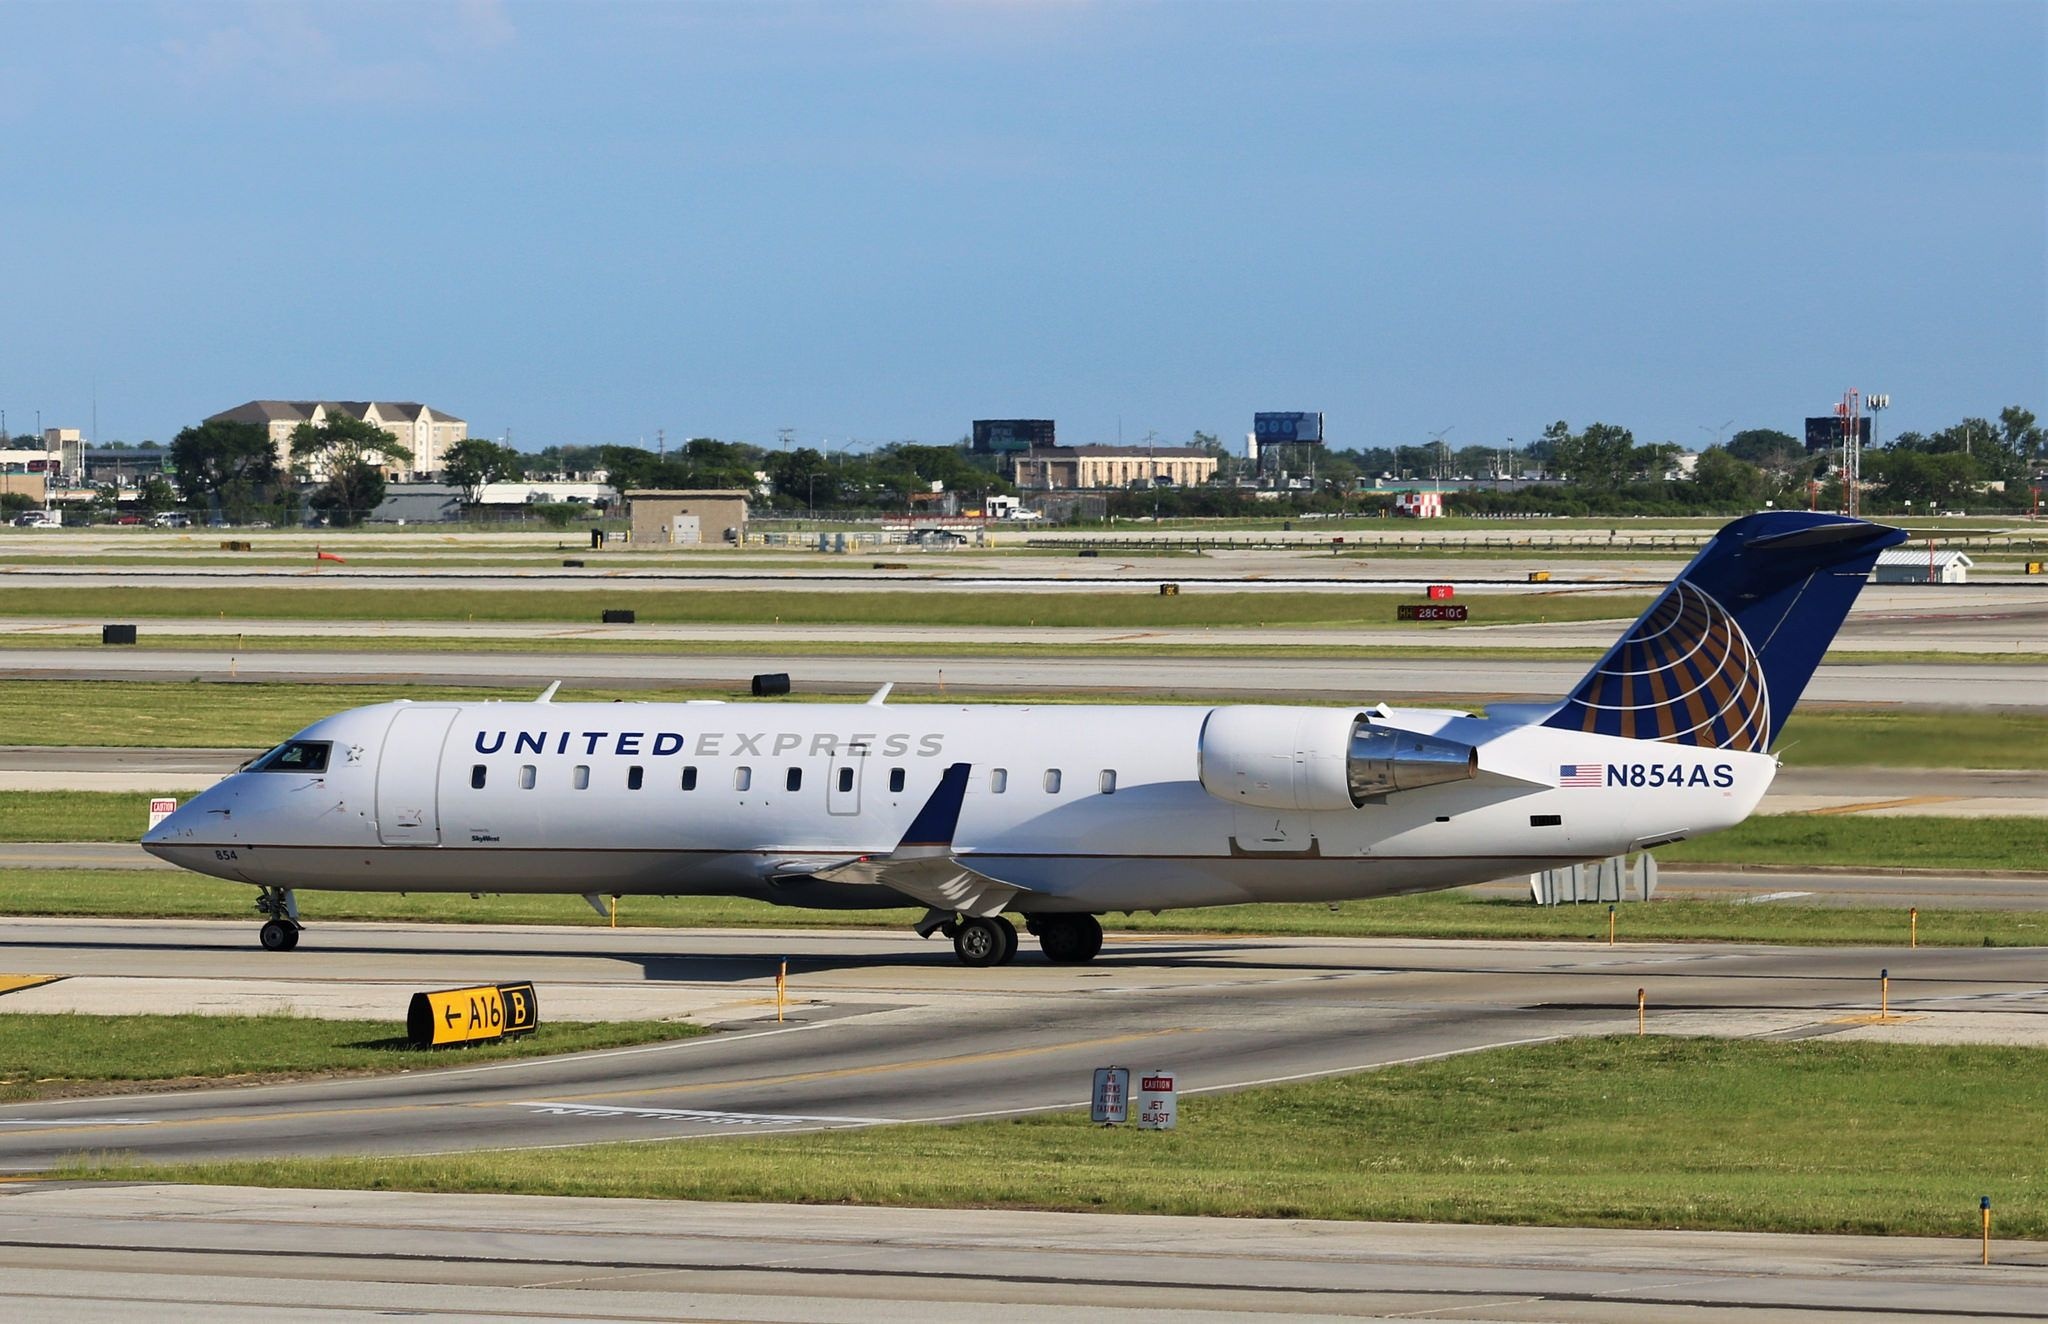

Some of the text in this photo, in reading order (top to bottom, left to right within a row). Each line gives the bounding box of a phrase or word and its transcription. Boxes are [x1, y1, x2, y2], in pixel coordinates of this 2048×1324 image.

[1419, 608, 1462, 618] 28C-10C
[474, 731, 945, 757] UNITED EXPRESS
[1607, 764, 1734, 788] N854AS
[153, 802, 174, 812] CAUTION
[471, 835, 500, 843] SkyWest
[215, 849, 238, 860] 854
[469, 992, 527, 1030] A16 B
[1144, 1079, 1170, 1089] CAUTION
[1100, 1094, 1120, 1103] ACTIVE
[1148, 1100, 1164, 1110] JET
[1142, 1113, 1170, 1123] BLAST
